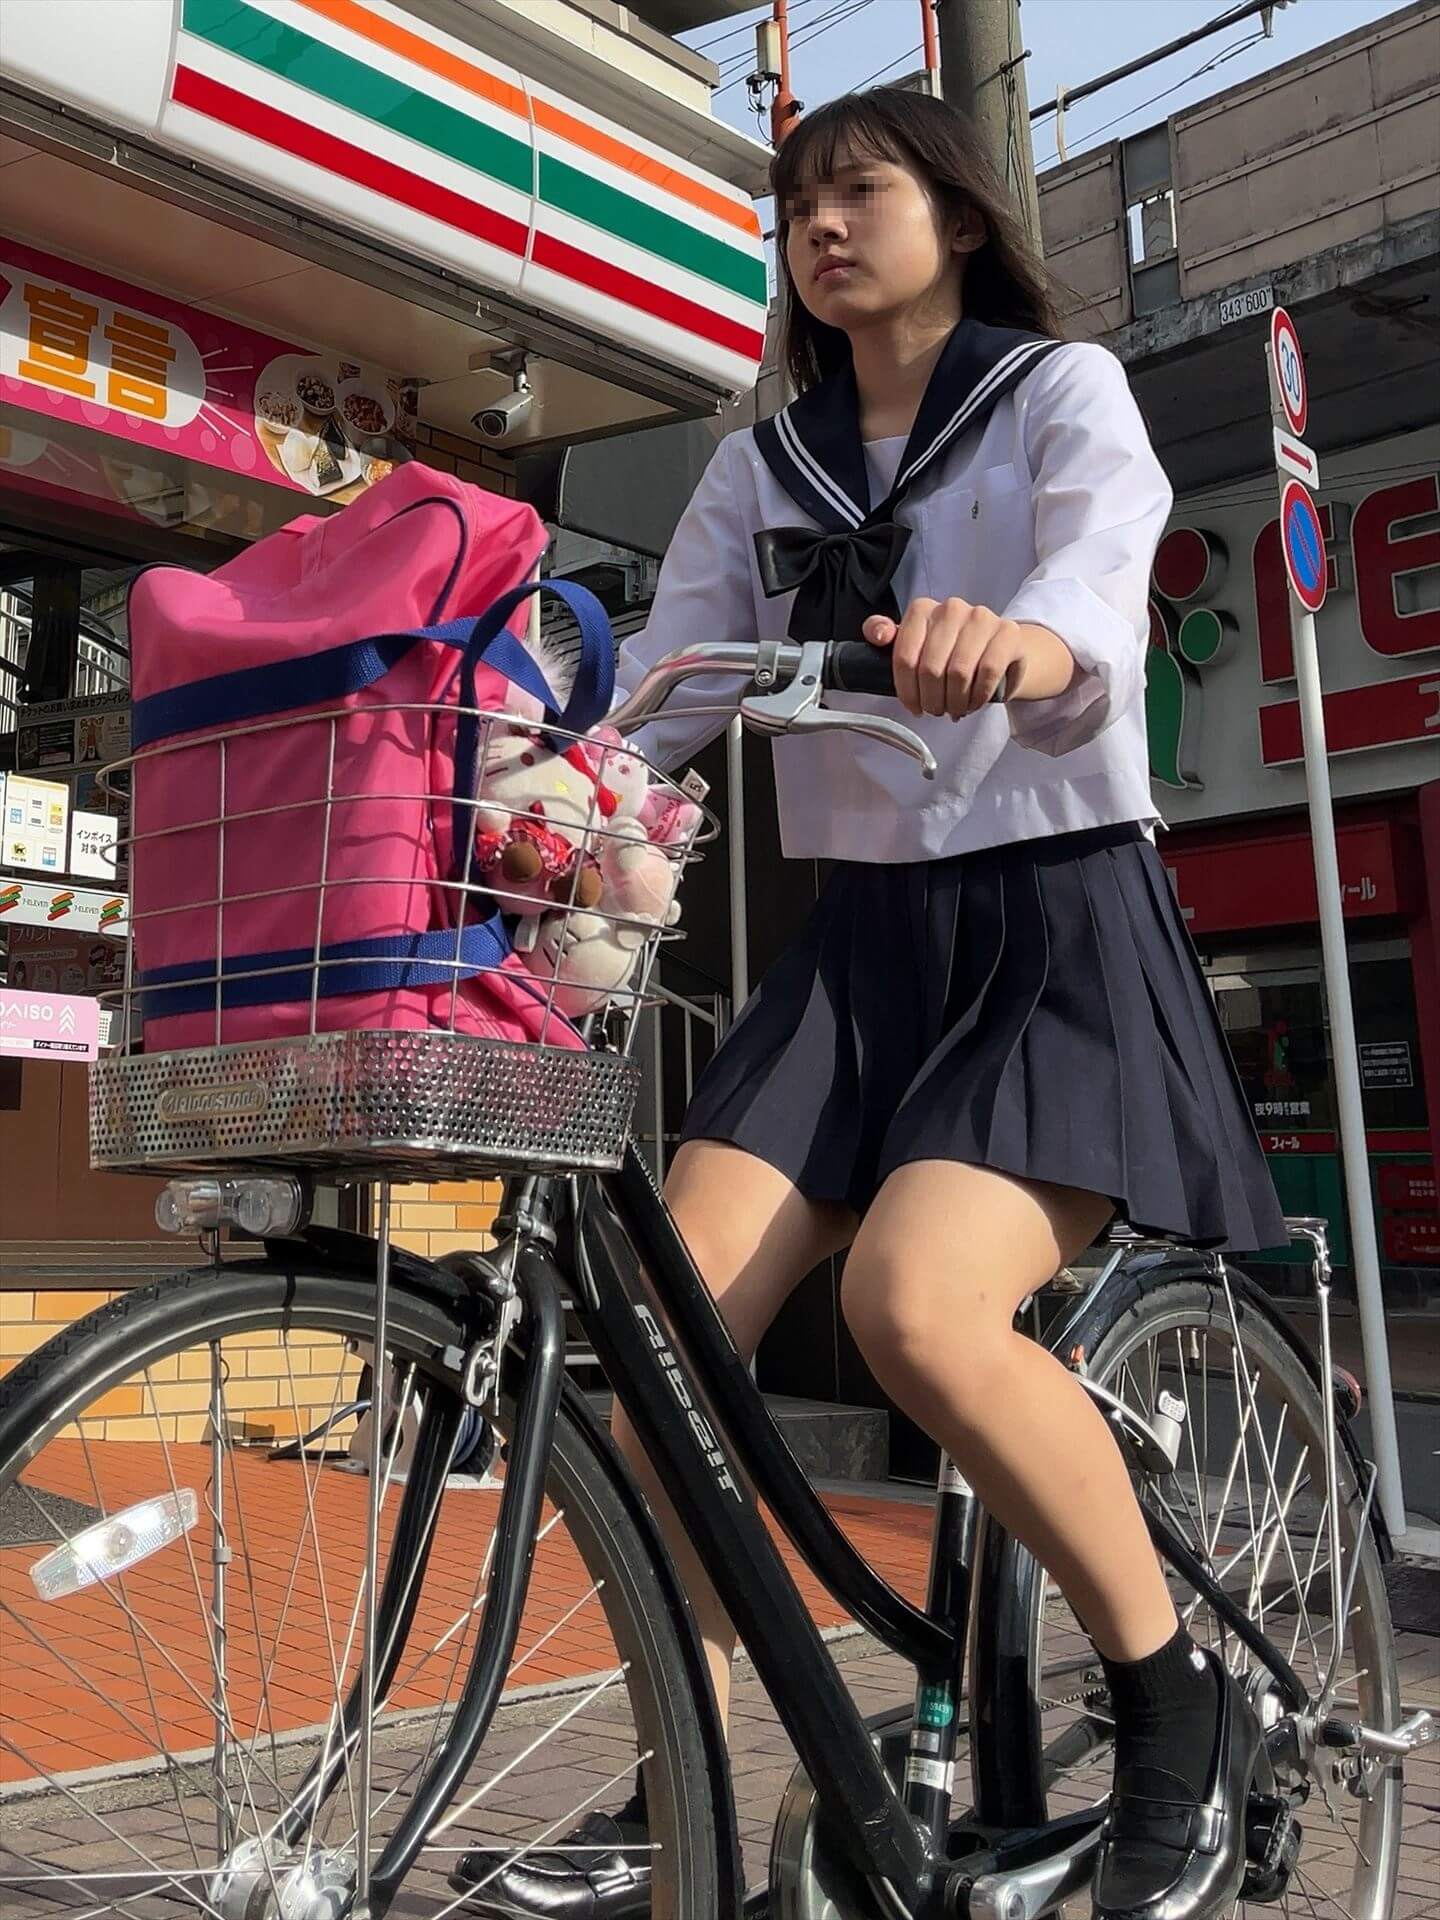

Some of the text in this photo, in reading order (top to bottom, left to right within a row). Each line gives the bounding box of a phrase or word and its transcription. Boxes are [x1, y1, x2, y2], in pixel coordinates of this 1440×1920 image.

[18, 282, 177, 420] 宣言
[1281, 341, 1300, 402] 30
[76, 829, 113, 844] インボイス
[1270, 1136, 1301, 1150] フィール
